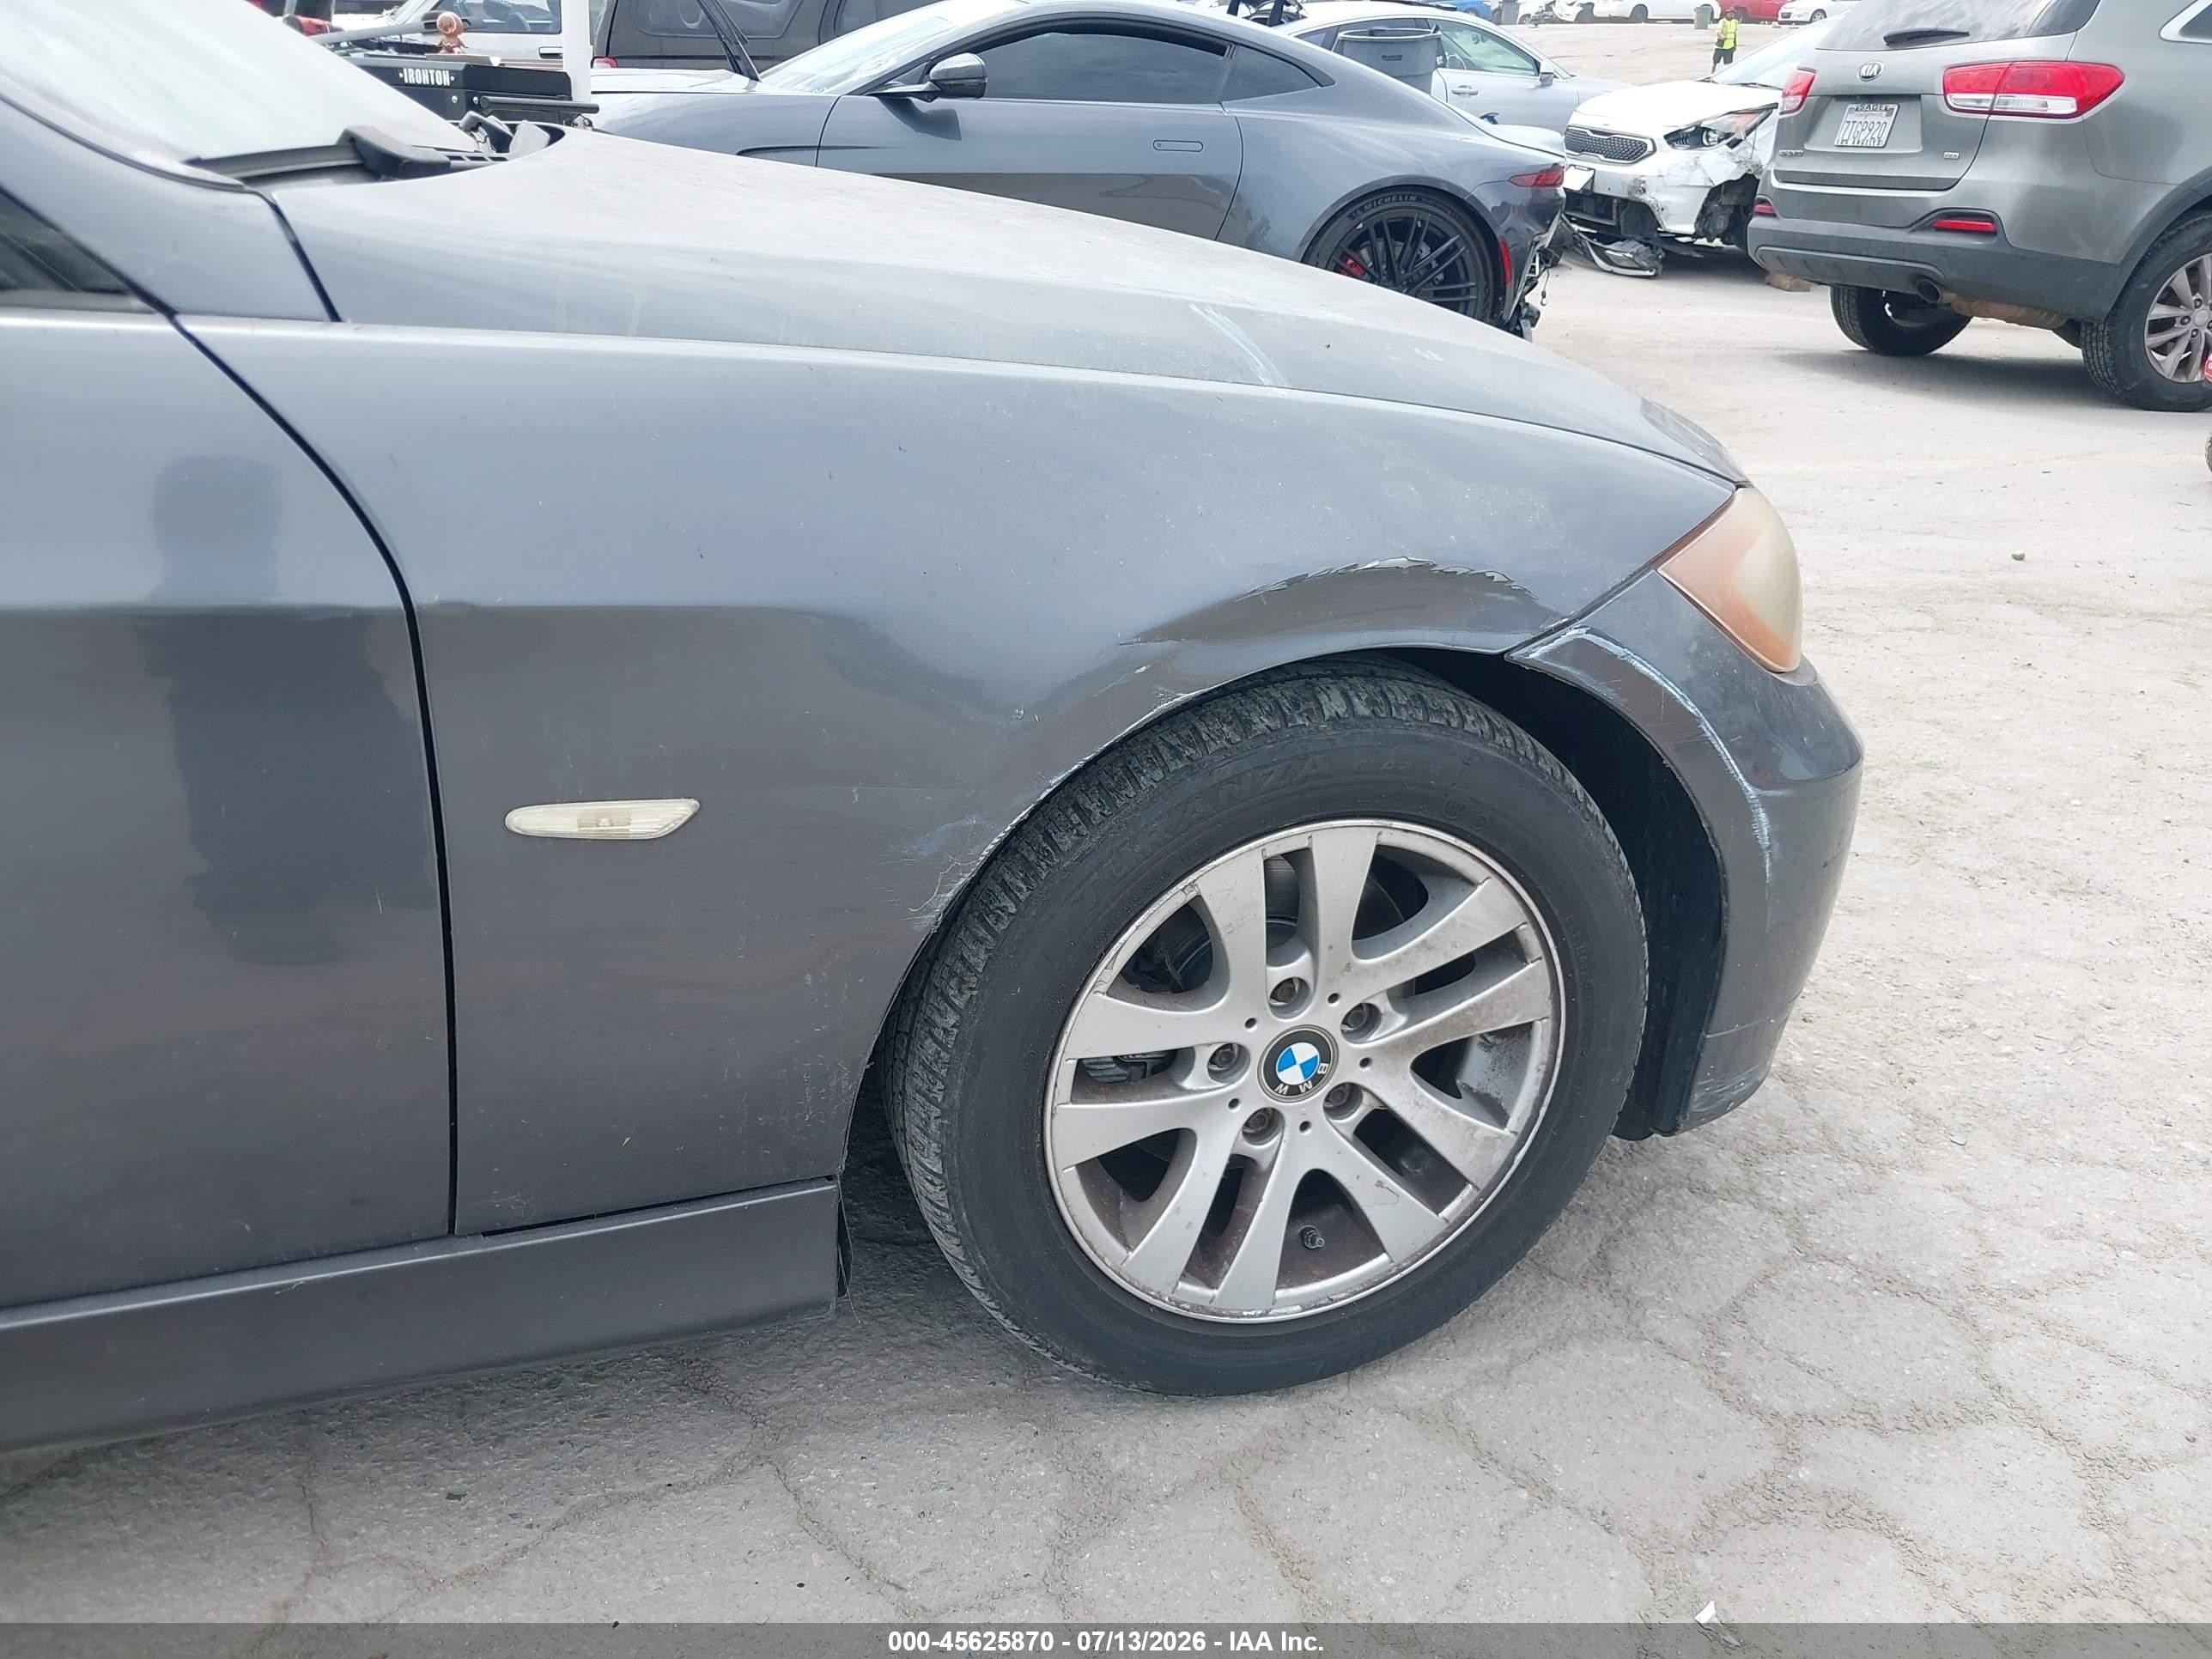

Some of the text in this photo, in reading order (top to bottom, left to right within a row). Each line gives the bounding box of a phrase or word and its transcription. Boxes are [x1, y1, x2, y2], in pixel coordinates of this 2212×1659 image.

[403, 68, 451, 86] IRONTON
[1364, 194, 1417, 210] MICHELIN
[1274, 1062, 1329, 1095] BMW
